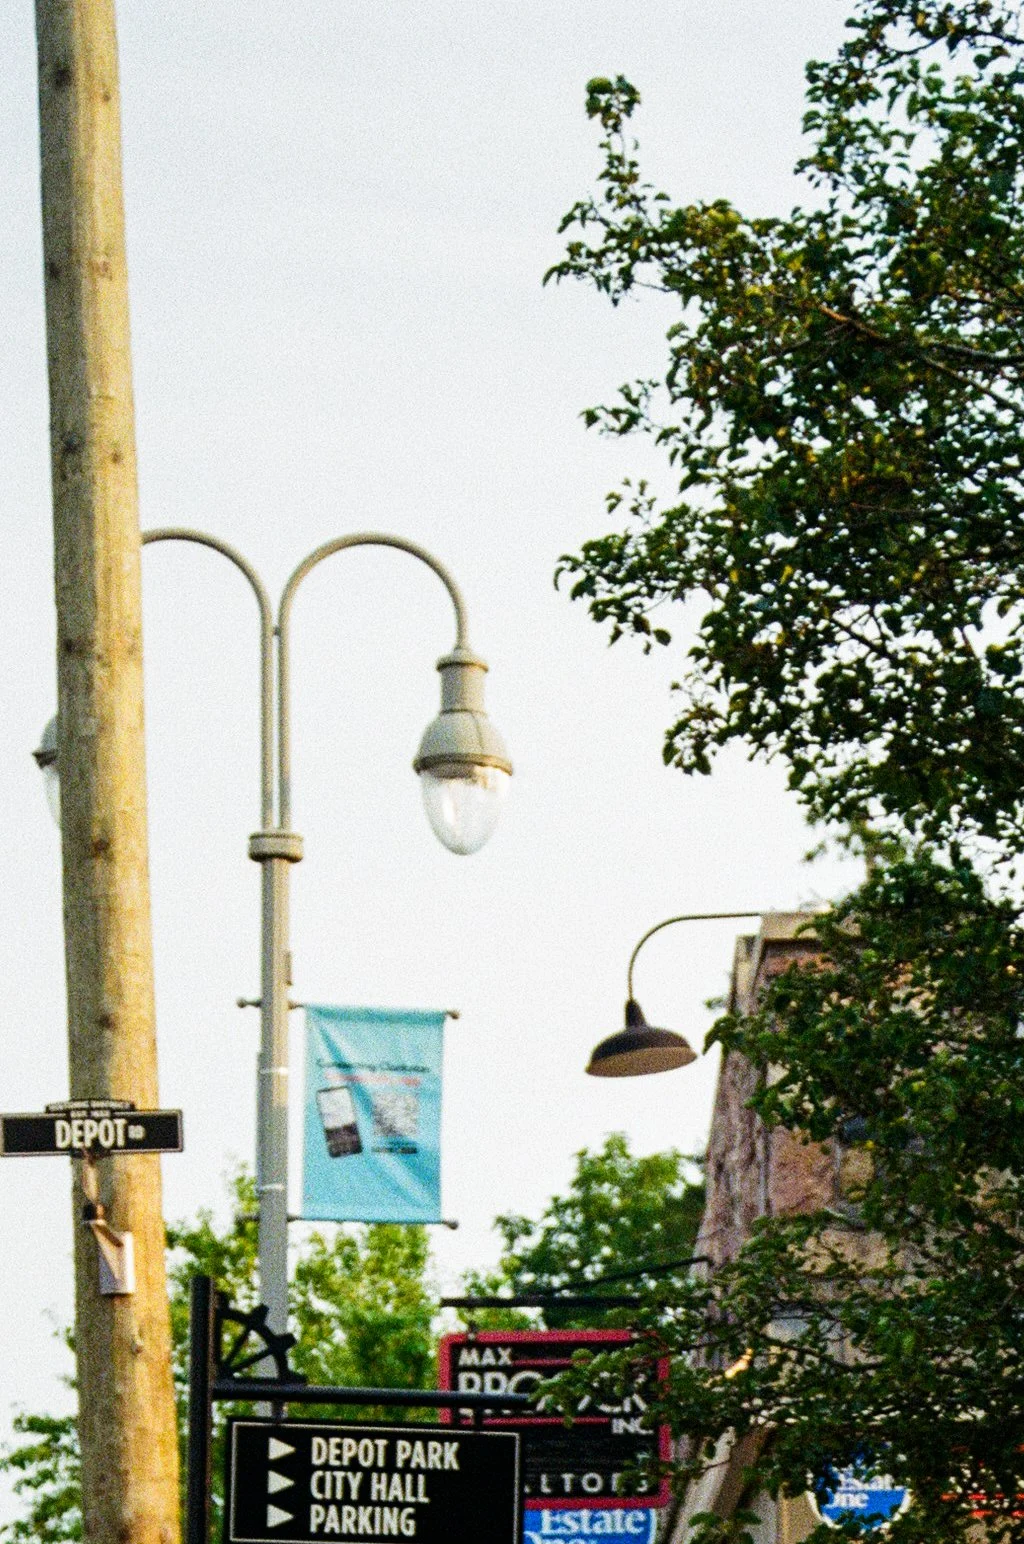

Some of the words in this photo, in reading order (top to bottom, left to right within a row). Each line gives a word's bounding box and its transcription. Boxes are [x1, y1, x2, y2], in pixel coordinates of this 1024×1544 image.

[55, 1118, 127, 1149] DEPOT
[457, 1347, 513, 1367] MAX
[311, 1436, 388, 1468] DEPOT
[396, 1440, 460, 1471] PARK
[310, 1470, 363, 1500] CITY
[371, 1472, 430, 1504] HALL
[310, 1504, 417, 1536] PARKING
[540, 1509, 647, 1535] Estate
